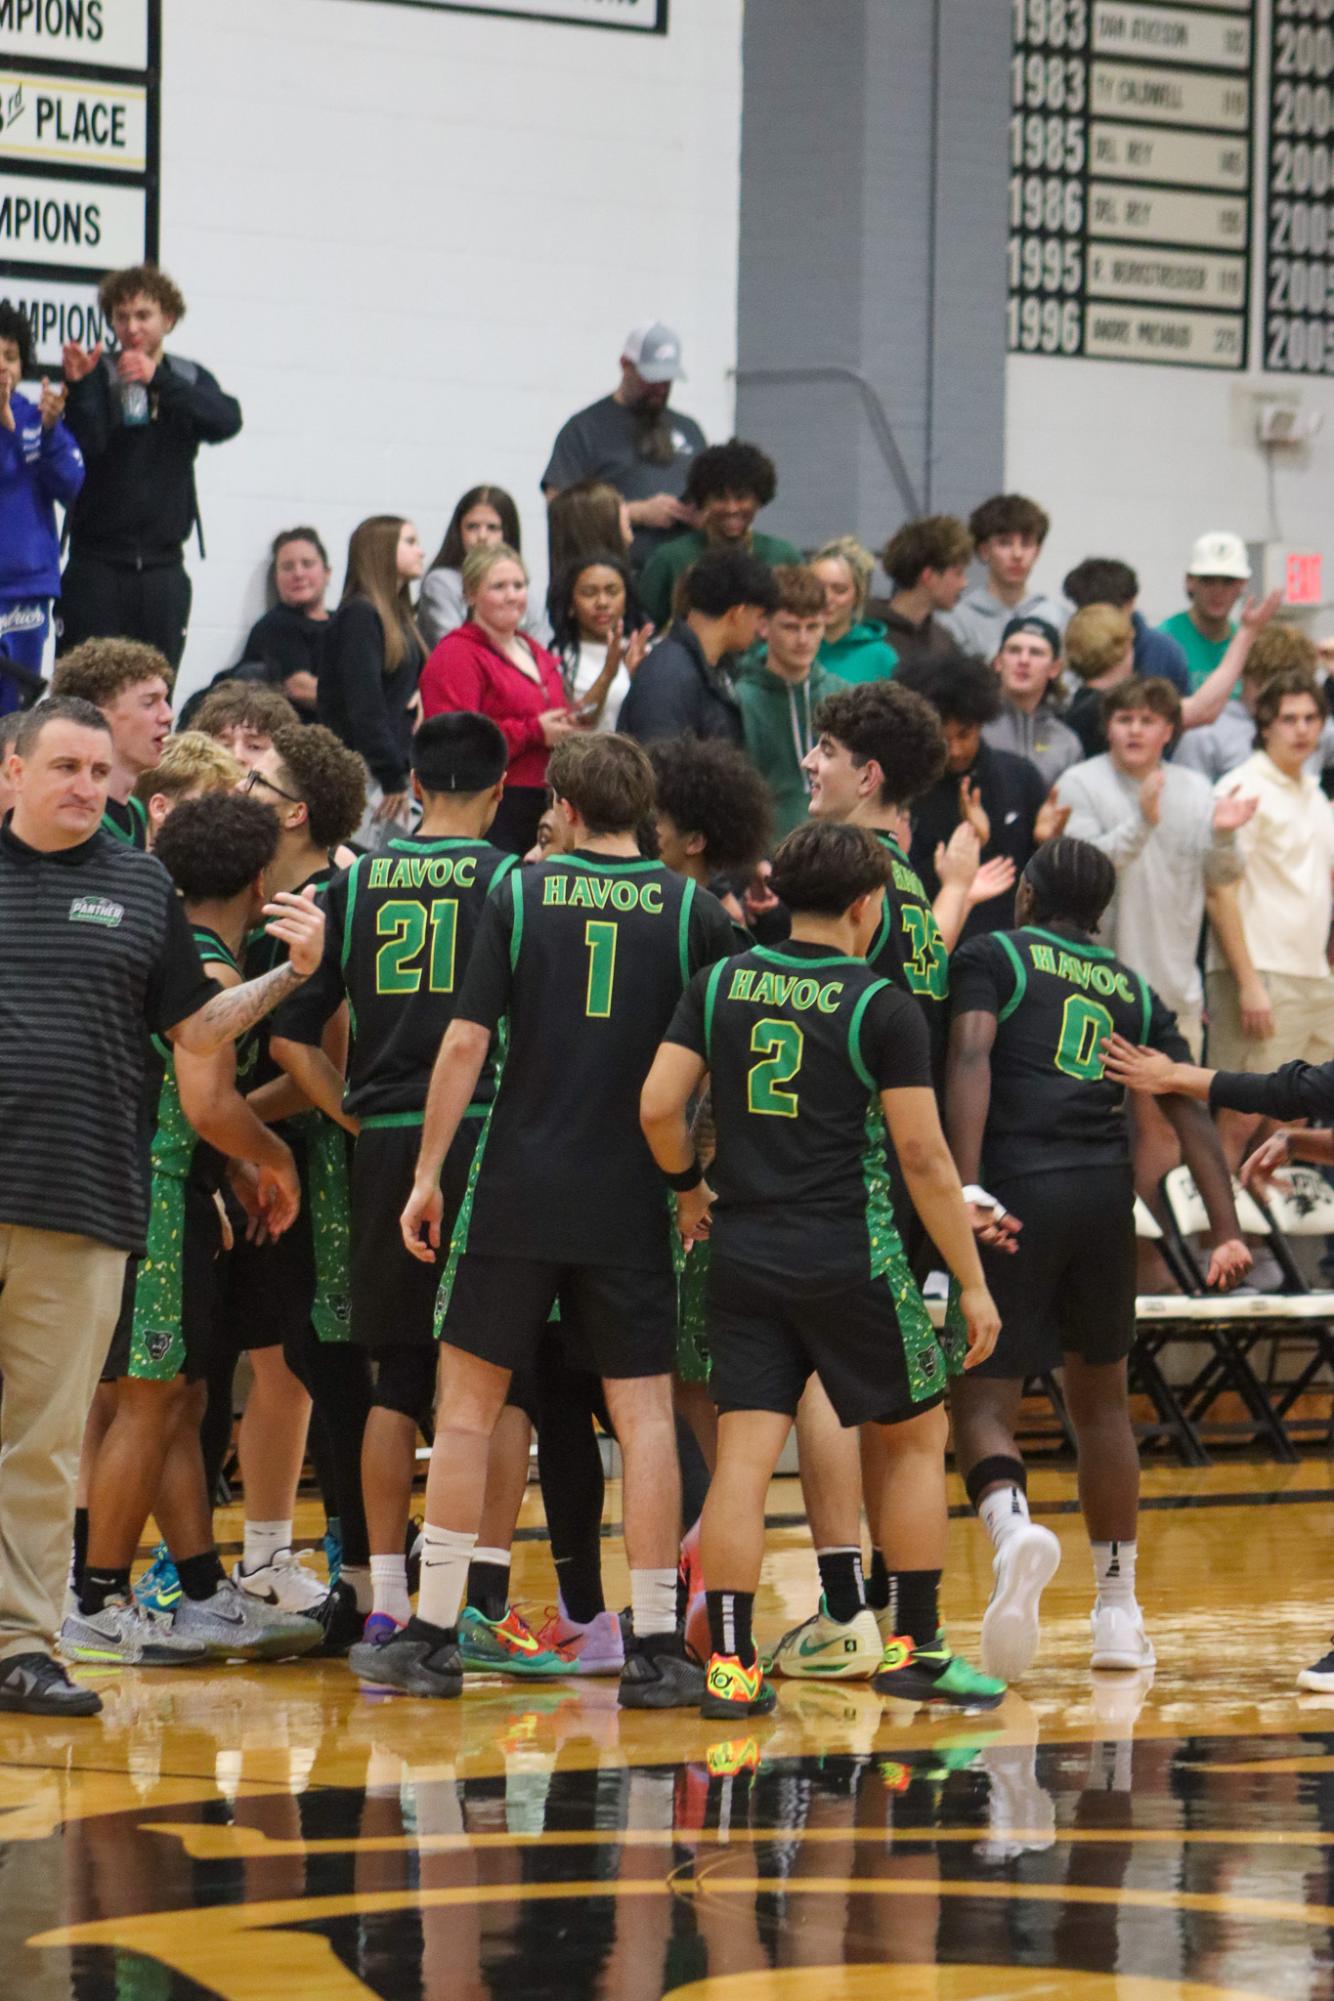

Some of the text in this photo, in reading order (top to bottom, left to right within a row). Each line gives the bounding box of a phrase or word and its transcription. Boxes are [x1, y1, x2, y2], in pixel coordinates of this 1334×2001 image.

[1012, 0, 1086, 49] 1983
[1011, 53, 1086, 112] 1983
[36, 96, 126, 147] PLACE
[1010, 113, 1085, 173] 1985
[1009, 175, 1083, 234] 1986
[1008, 236, 1082, 293] 1995
[1008, 297, 1080, 353] 1996
[367, 857, 478, 889] HAVOC
[542, 875, 664, 914] HAVOC
[375, 898, 460, 995] 21
[584, 919, 618, 1018] 1
[1029, 944, 1136, 1004] HAVOC
[727, 968, 844, 1013] HAVOC
[1054, 993, 1114, 1081] 0
[747, 1017, 804, 1118] 2
